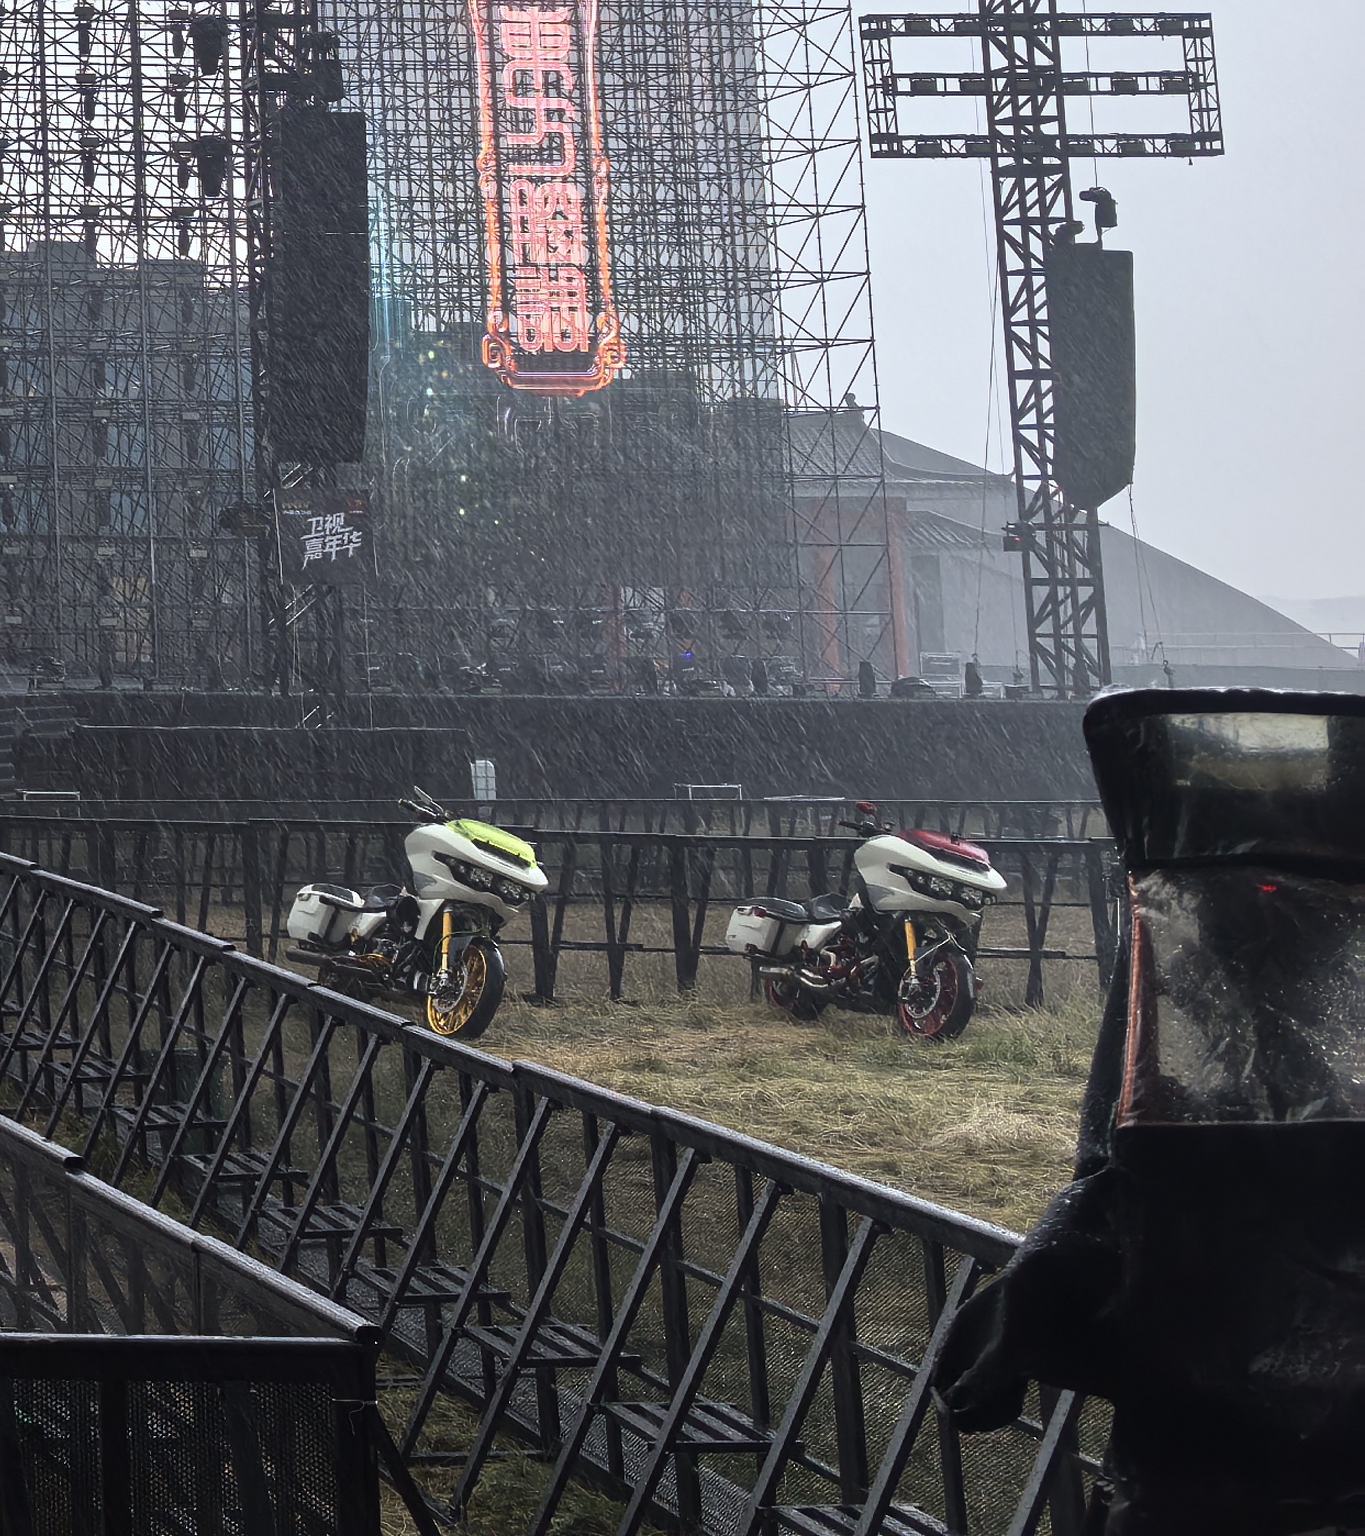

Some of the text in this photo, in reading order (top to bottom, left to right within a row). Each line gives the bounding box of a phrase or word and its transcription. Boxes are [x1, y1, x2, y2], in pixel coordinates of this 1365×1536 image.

[301, 513, 354, 539] 卫视
[301, 531, 363, 570] 嘉年华
